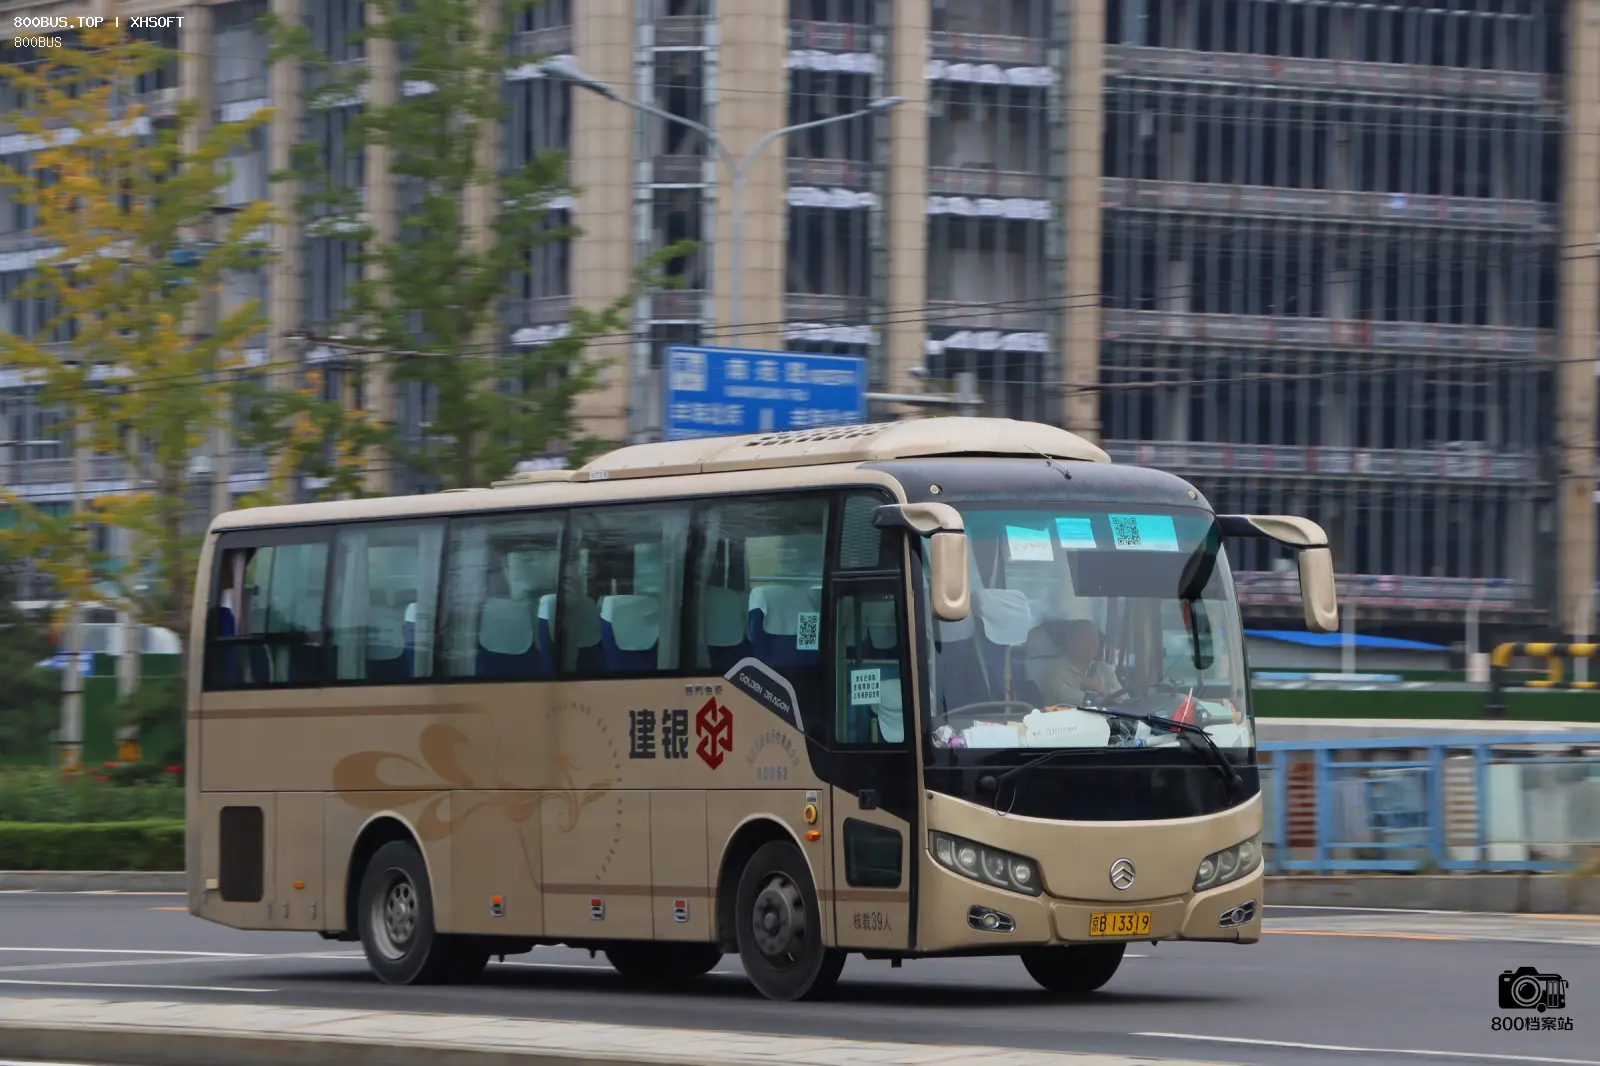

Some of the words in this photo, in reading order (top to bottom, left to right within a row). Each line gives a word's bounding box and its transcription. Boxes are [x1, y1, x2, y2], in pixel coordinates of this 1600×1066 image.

[739, 672, 764, 695] GOLDEN
[764, 689, 790, 714] DRAGON
[628, 708, 689, 760] 建银
[852, 911, 892, 931] 核载39人
